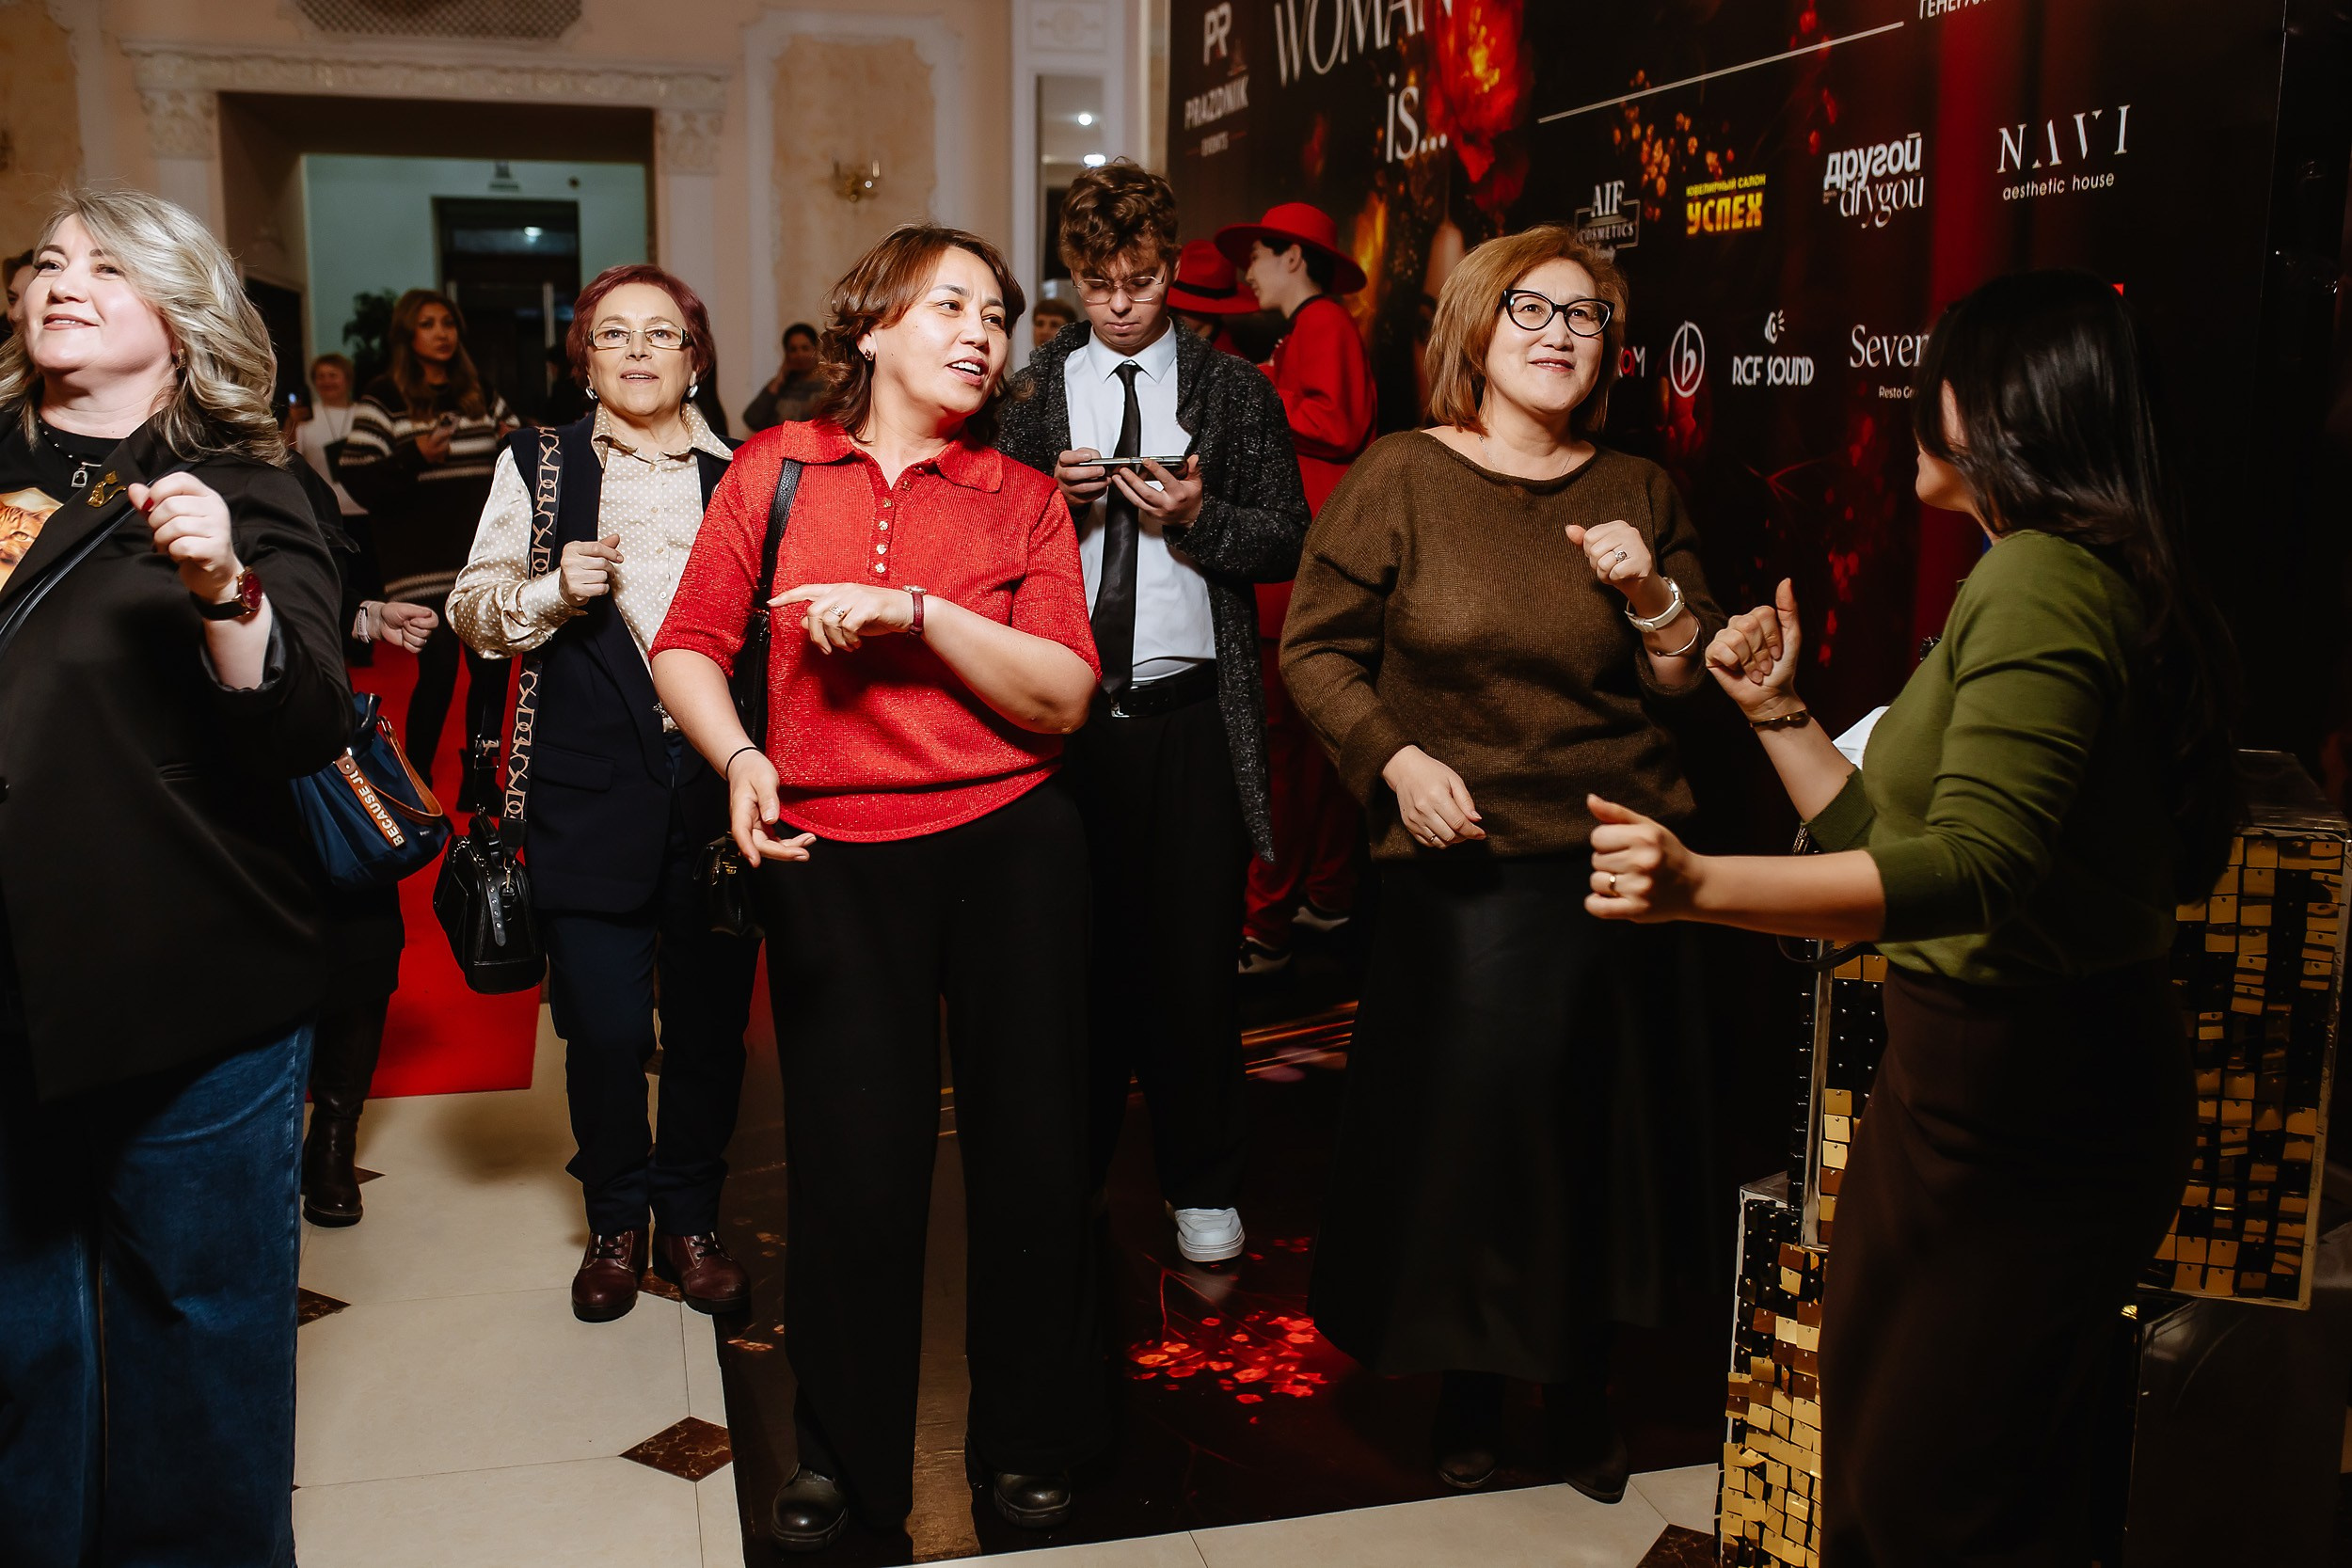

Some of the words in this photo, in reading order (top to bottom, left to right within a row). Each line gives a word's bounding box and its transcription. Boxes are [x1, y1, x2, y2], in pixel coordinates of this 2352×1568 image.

[1203, 2, 1232, 66] PR
[1996, 104, 2131, 174] NAVI
[1590, 180, 1626, 218] AIF
[1737, 173, 1766, 189] САЛОН
[2002, 177, 2066, 201] aesthetic
[2072, 172, 2115, 192] house
[1686, 191, 1764, 235] УСПЕХ
[1732, 356, 1763, 386] RCF
[1767, 355, 1815, 387] SOUND
[1879, 385, 1901, 399] Resto
[358, 785, 405, 847] BECAUSE
